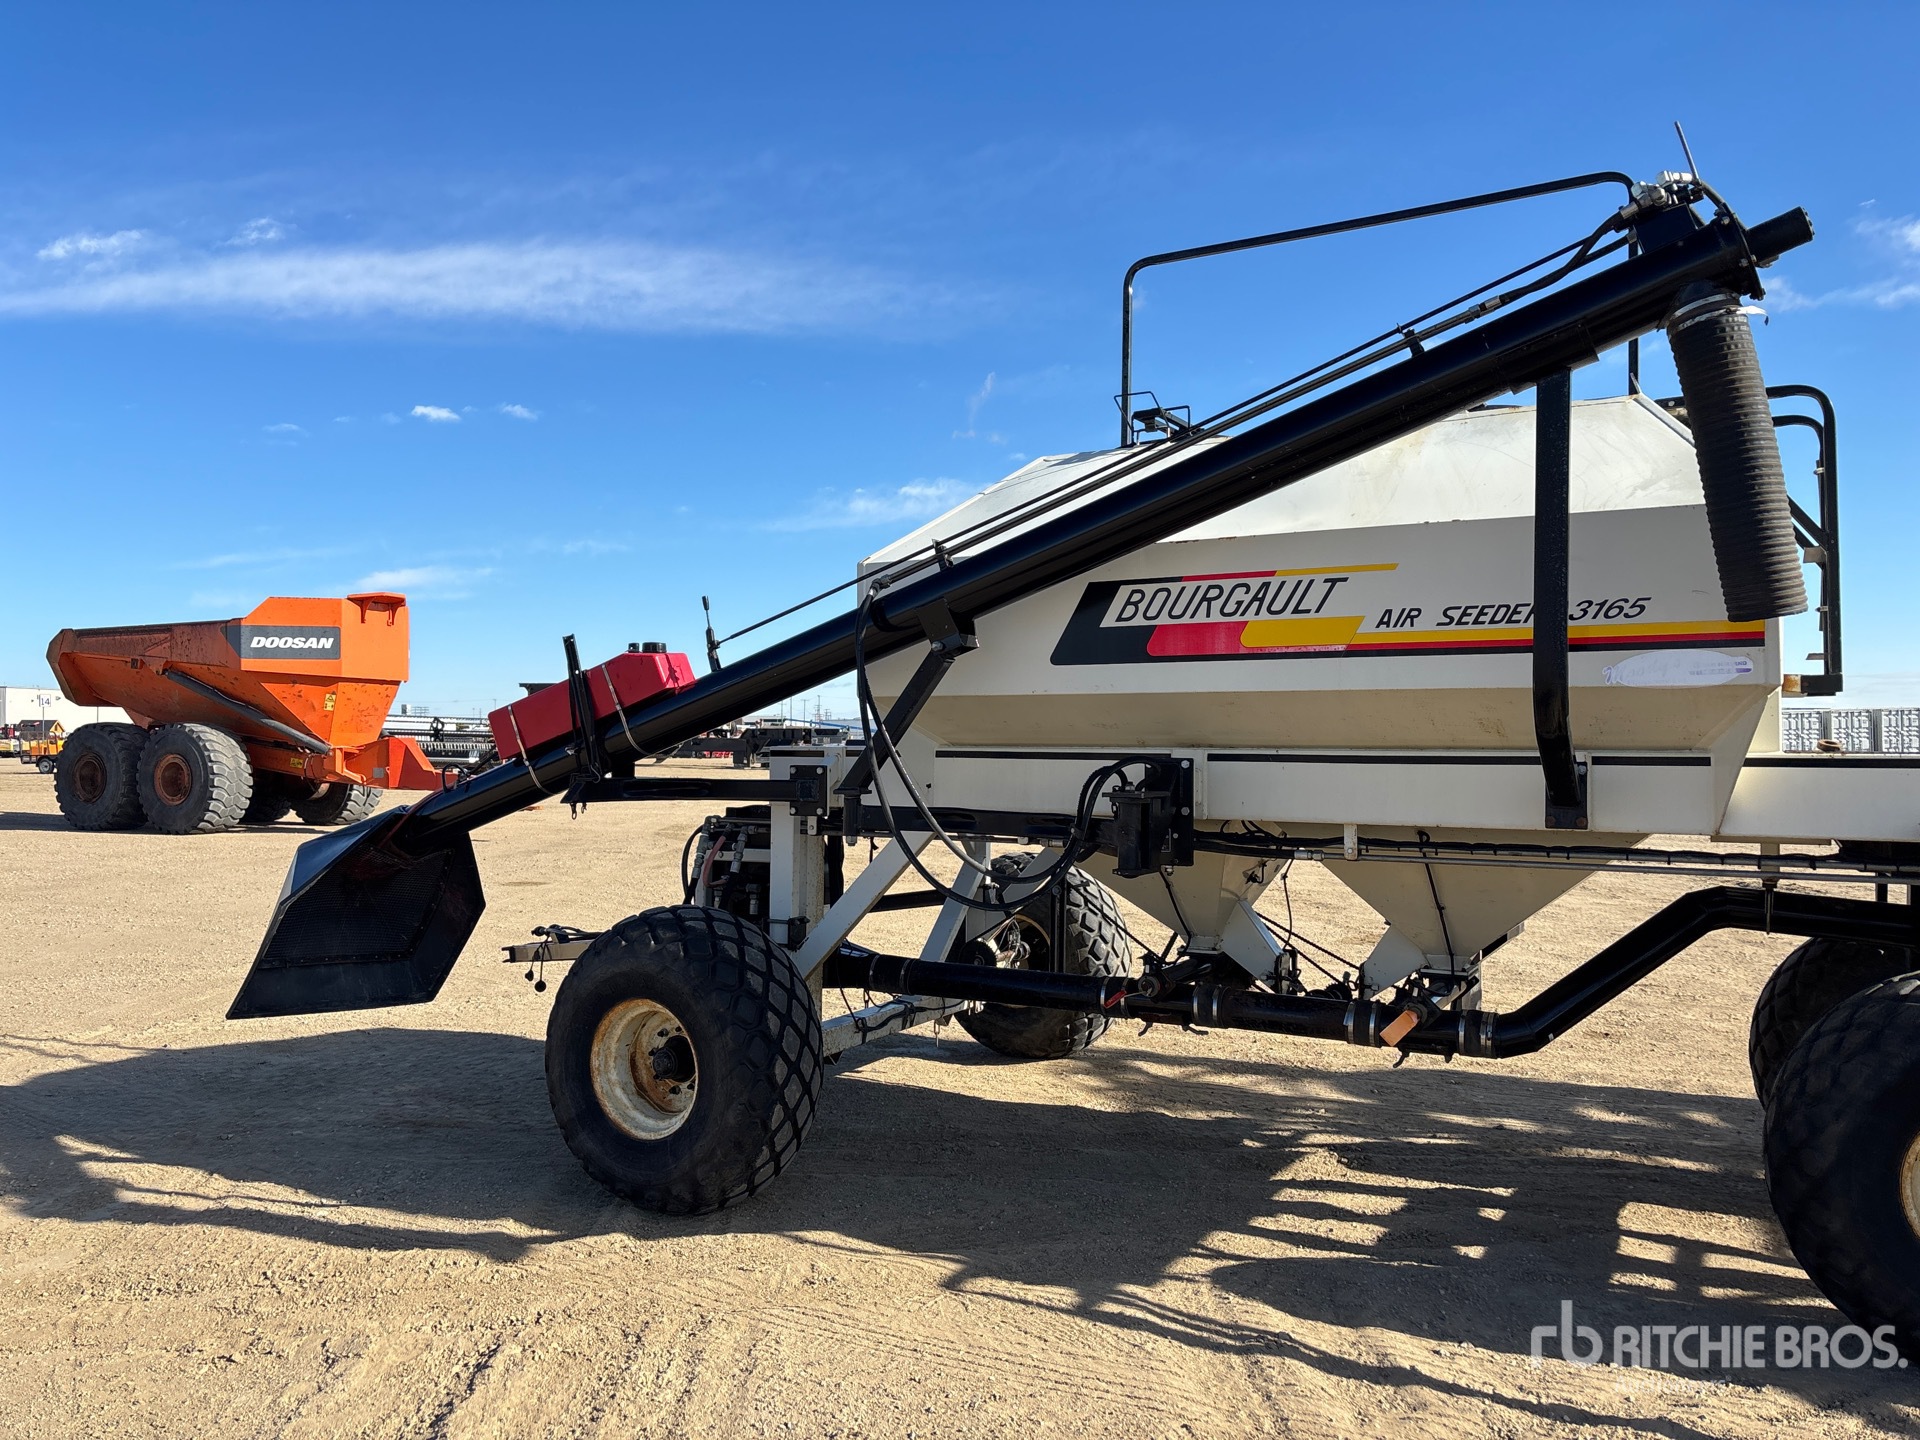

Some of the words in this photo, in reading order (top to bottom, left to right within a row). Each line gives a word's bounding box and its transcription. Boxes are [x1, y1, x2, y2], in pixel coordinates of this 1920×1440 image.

[1115, 576, 1349, 623] BOURGAULT
[1375, 607, 1422, 629] AIR
[1568, 596, 1652, 621] 3165
[249, 636, 335, 649] DOOSAN
[41, 697, 50, 706] 14
